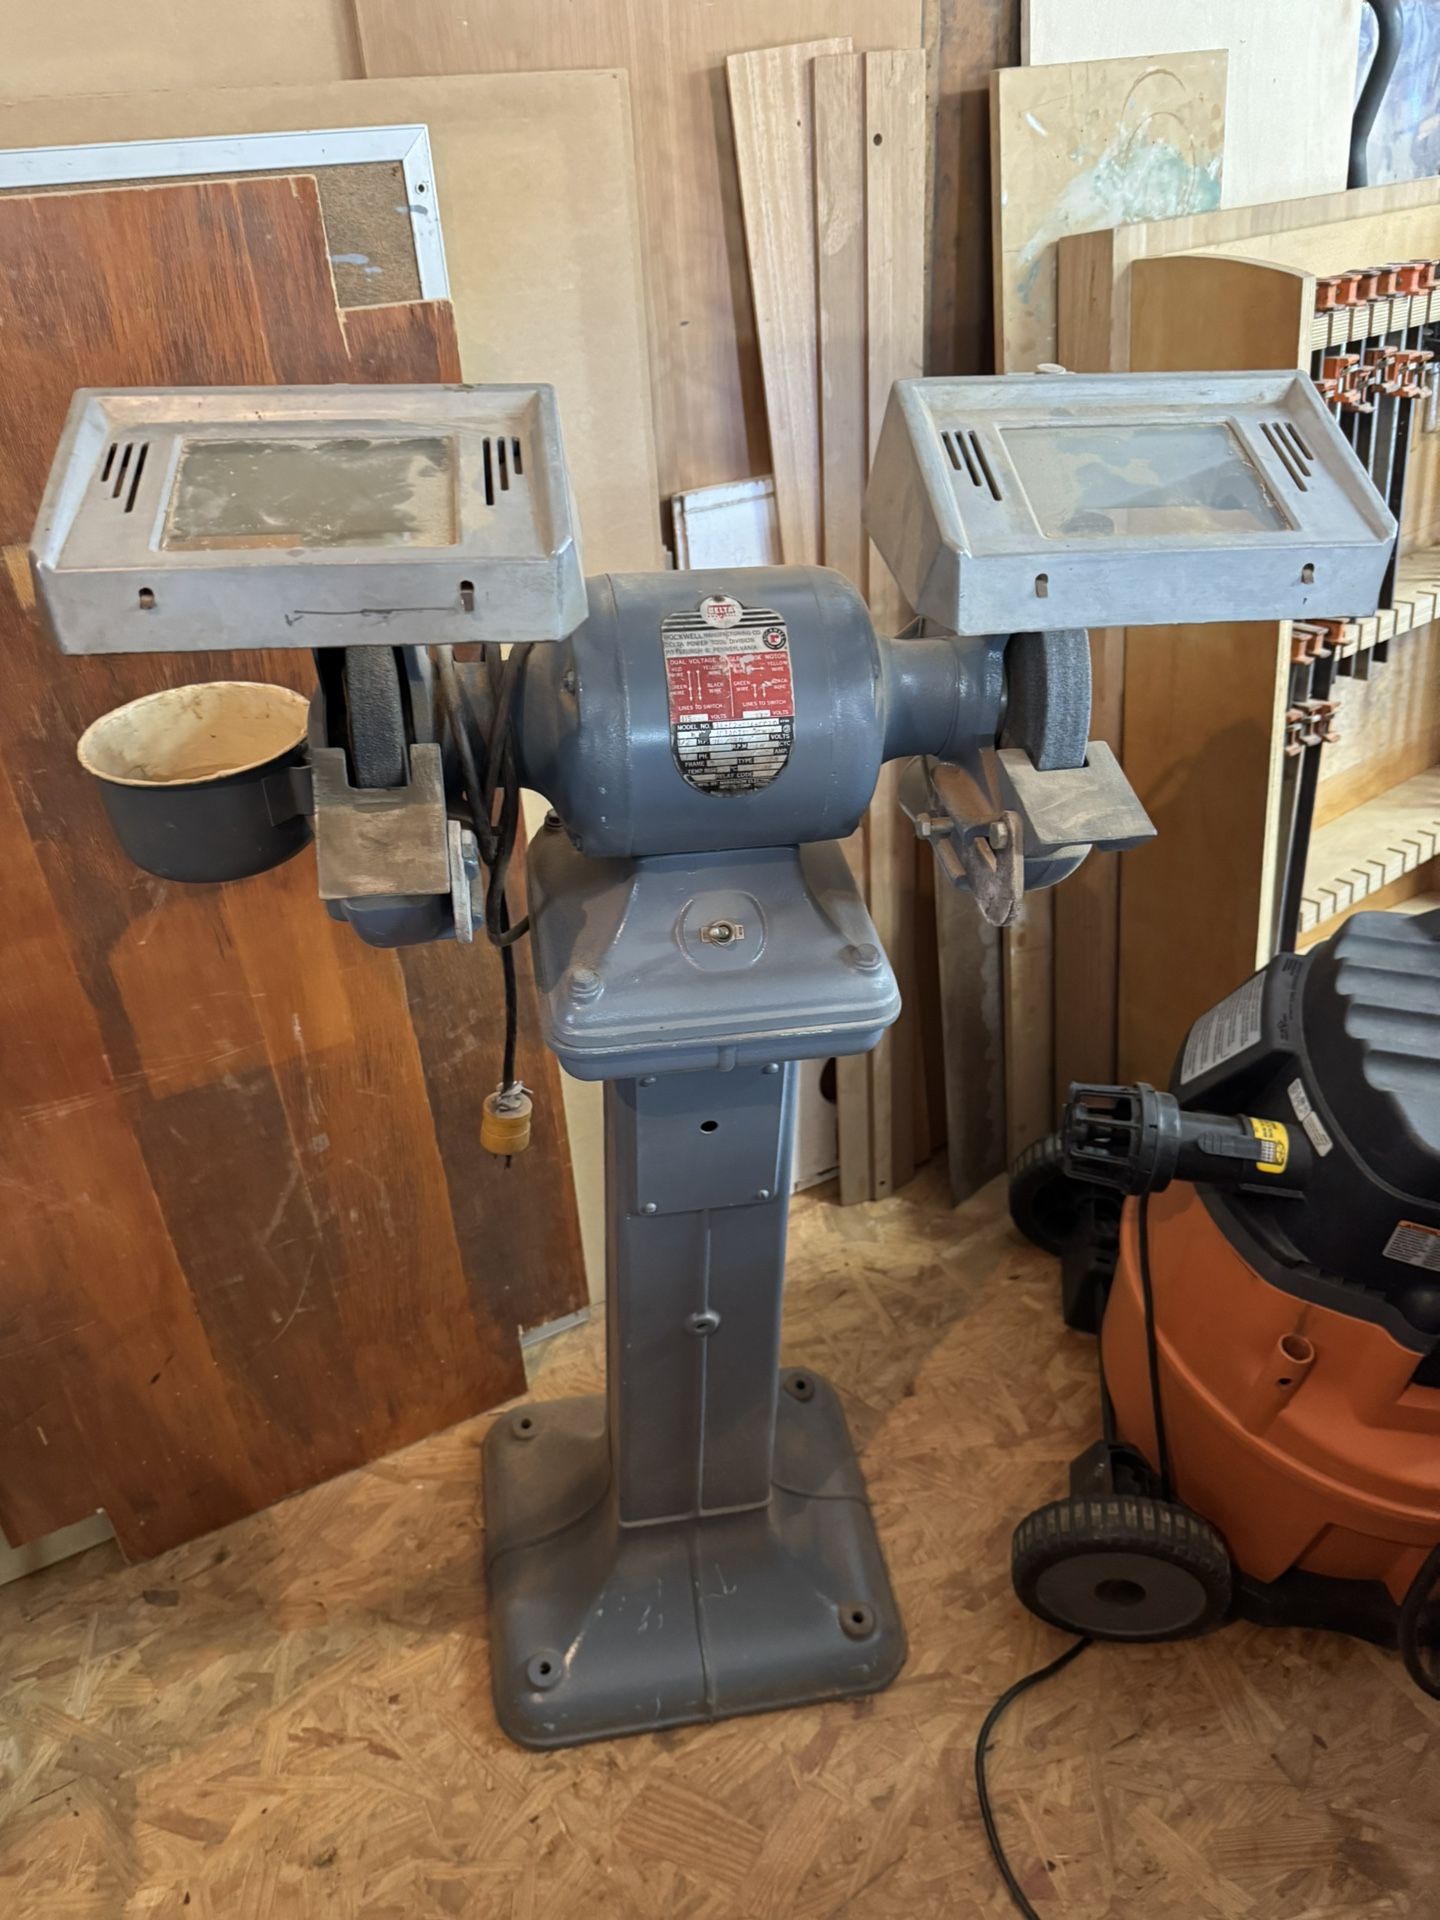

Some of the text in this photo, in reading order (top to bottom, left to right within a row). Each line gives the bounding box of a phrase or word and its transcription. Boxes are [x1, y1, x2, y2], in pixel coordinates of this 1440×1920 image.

[663, 632, 703, 640] ROCKWELL
[712, 645, 758, 653] PENNSYLVANIA
[677, 723, 698, 731] MODEL
[738, 757, 753, 765] TYPE
